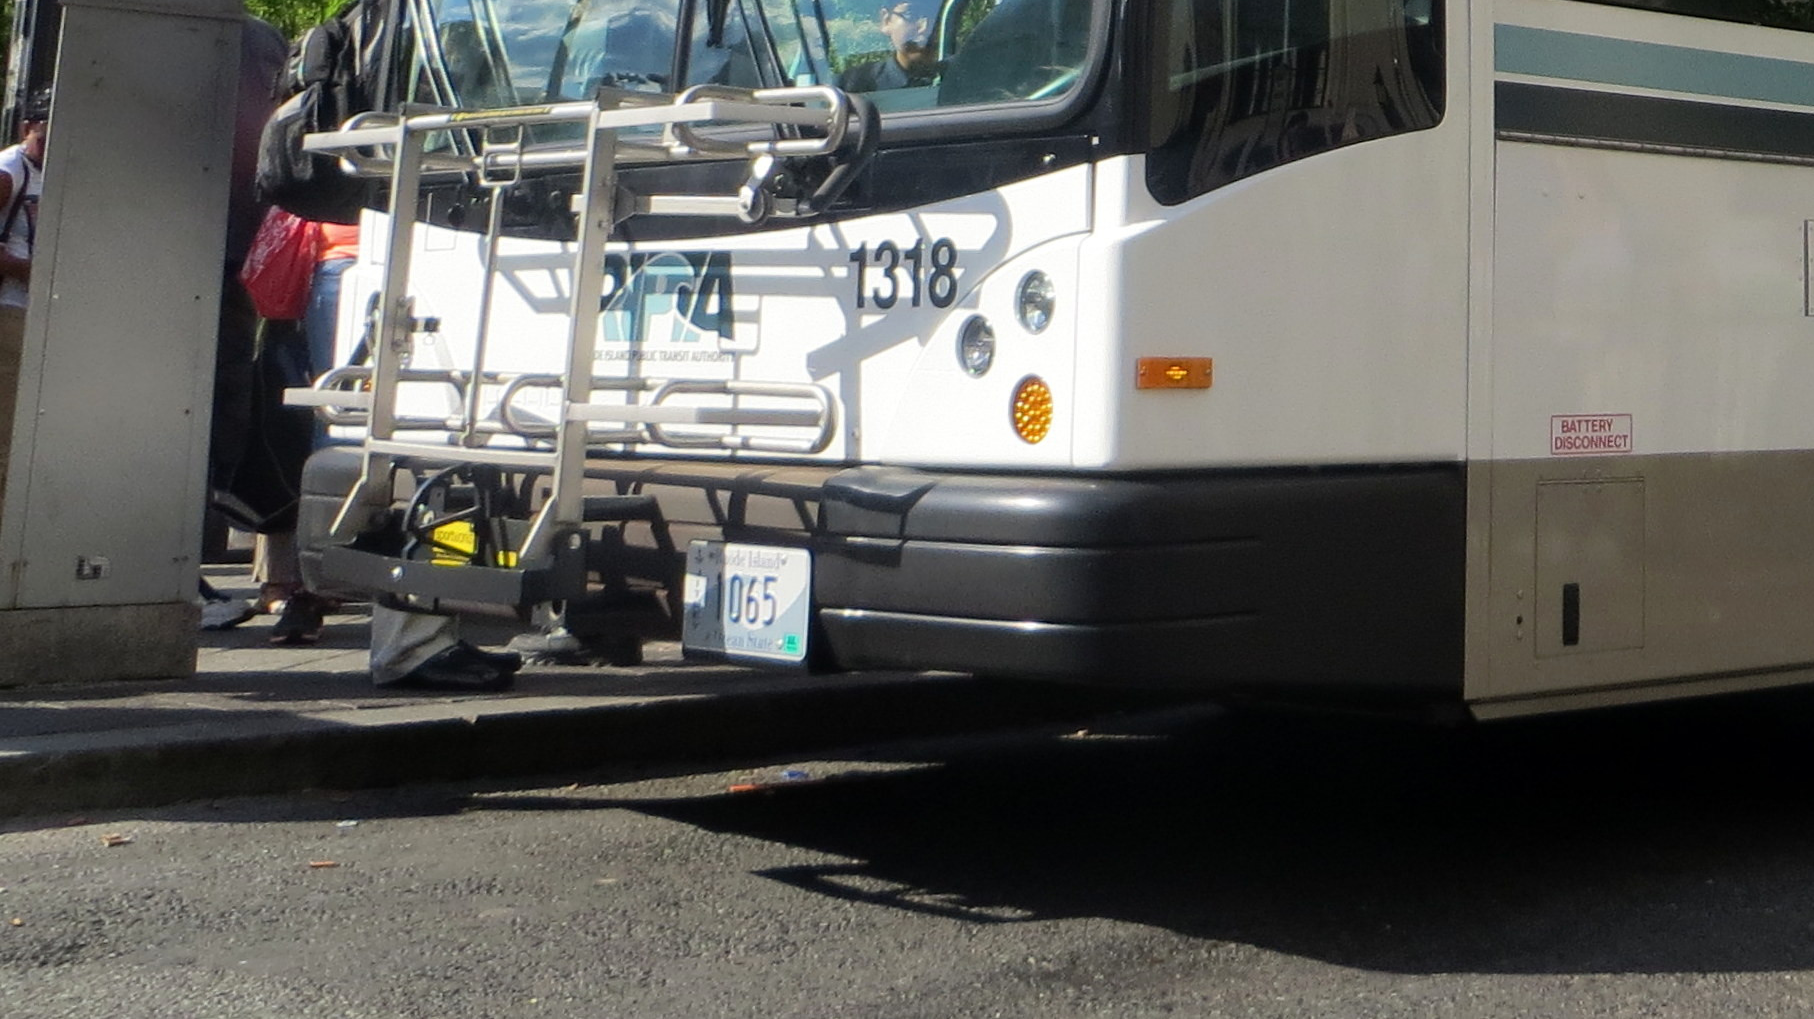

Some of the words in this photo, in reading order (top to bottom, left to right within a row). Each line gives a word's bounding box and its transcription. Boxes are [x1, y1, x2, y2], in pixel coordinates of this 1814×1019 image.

[849, 237, 958, 310] 1318
[1554, 434, 1629, 451] DISCONNECT
[1561, 418, 1614, 434] BATTERY
[717, 571, 778, 627] 1065
